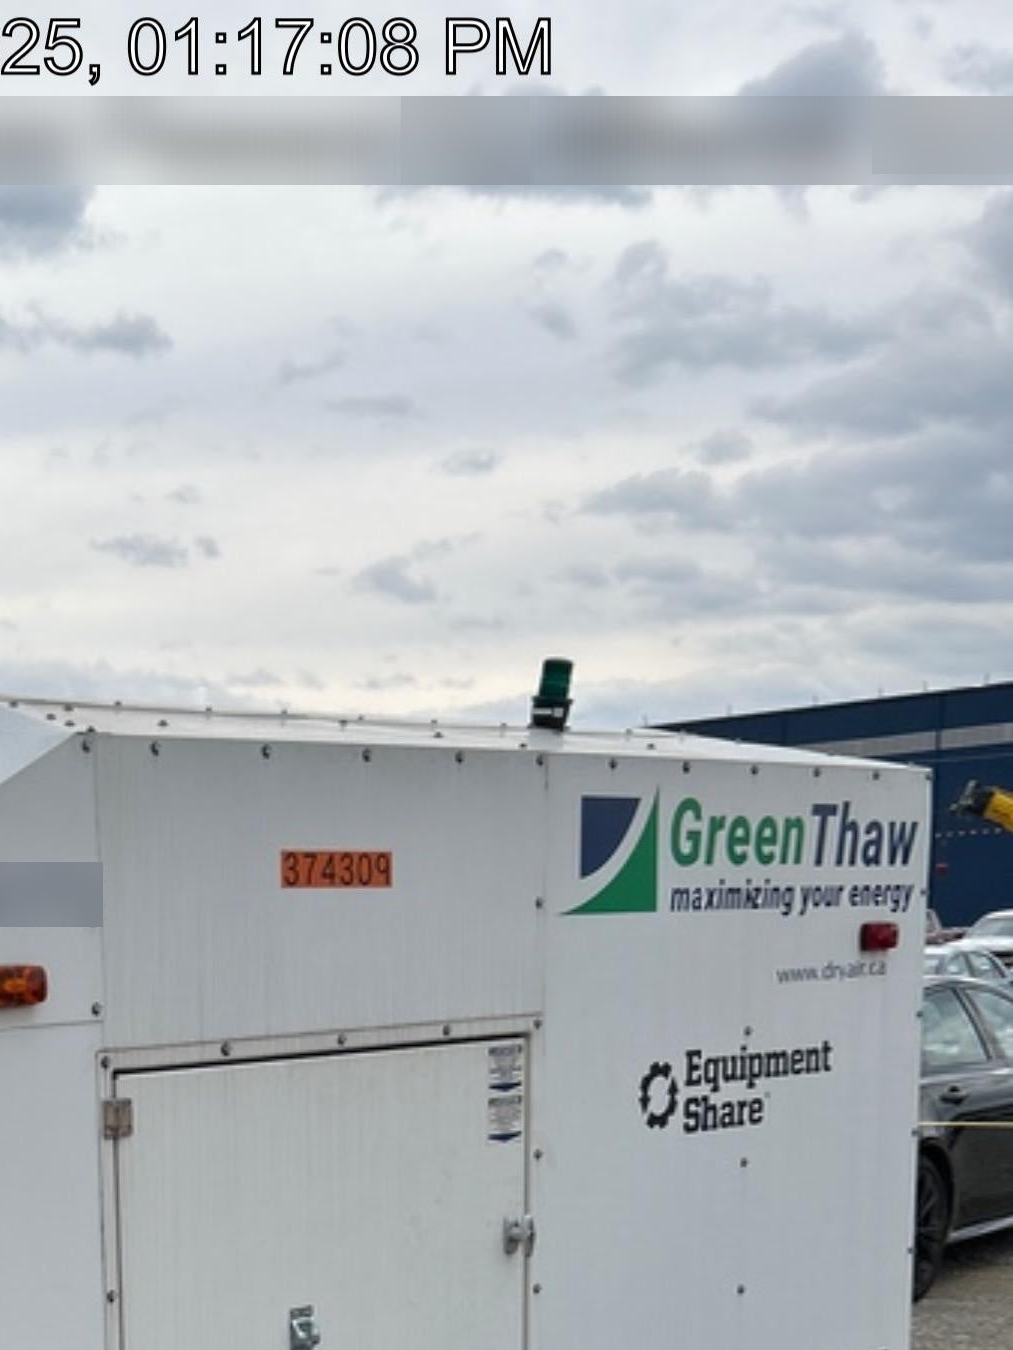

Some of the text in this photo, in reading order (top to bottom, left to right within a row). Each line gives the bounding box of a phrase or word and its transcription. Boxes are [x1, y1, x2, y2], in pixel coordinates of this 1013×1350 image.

[283, 851, 391, 886] 374309
[670, 878, 915, 916] maximizing your energy
[684, 1040, 832, 1093] Equipment
[683, 1094, 763, 1134] Share
